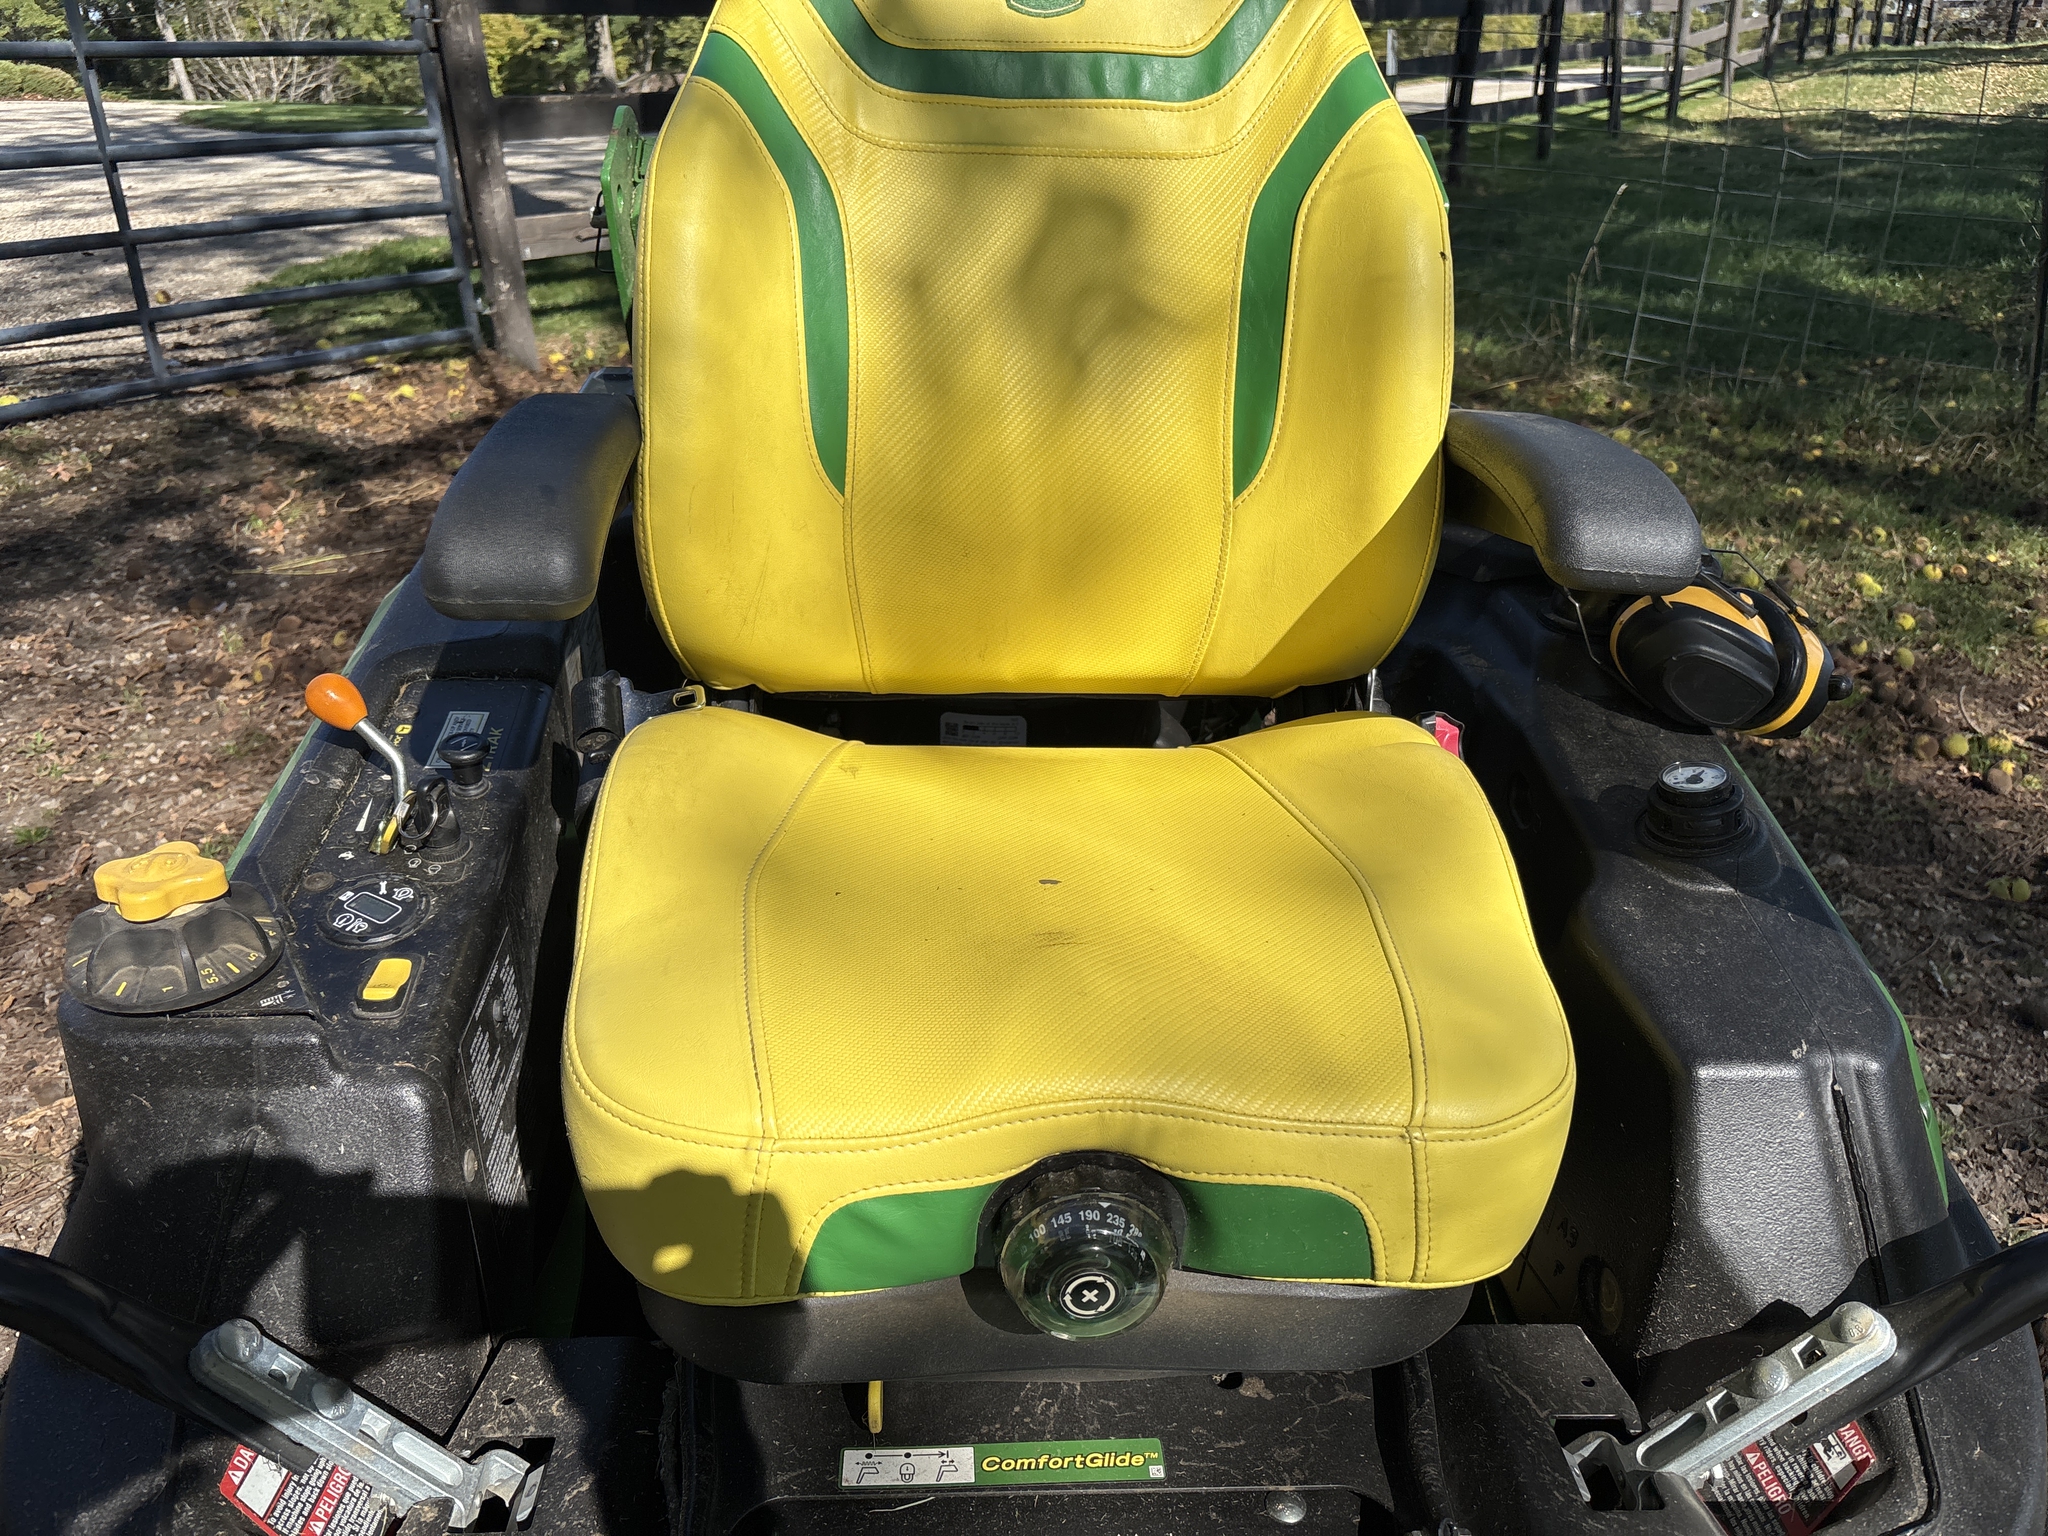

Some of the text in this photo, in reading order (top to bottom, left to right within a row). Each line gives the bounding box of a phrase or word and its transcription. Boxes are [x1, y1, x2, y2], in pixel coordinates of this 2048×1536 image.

[200, 967, 219, 985] 5.5
[1029, 1223, 1047, 1242] 100
[1050, 1212, 1073, 1228] 145
[1078, 1209, 1100, 1221] 190
[1106, 1212, 1126, 1229] 235
[1739, 1464, 1749, 1474] las
[1772, 1445, 1785, 1462] when
[266, 1515, 276, 1526] To
[271, 1497, 286, 1517] avoid
[280, 1479, 297, 1500] injury
[274, 1507, 291, 1530] across
[299, 1471, 310, 1484] not
[283, 1500, 303, 1529] machine
[298, 1484, 313, 1503] stops
[306, 1467, 322, 1486] going
[299, 1501, 312, 1516] and
[306, 1486, 320, 1503] back
[315, 1469, 329, 1487] down
[337, 1496, 358, 1527] volcadura
[352, 1487, 361, 1497] de
[346, 1489, 370, 1523] transversal
[1750, 1460, 1793, 1516] PELIGRO
[327, 1502, 346, 1529] lesiones
[341, 1490, 353, 1504] que
